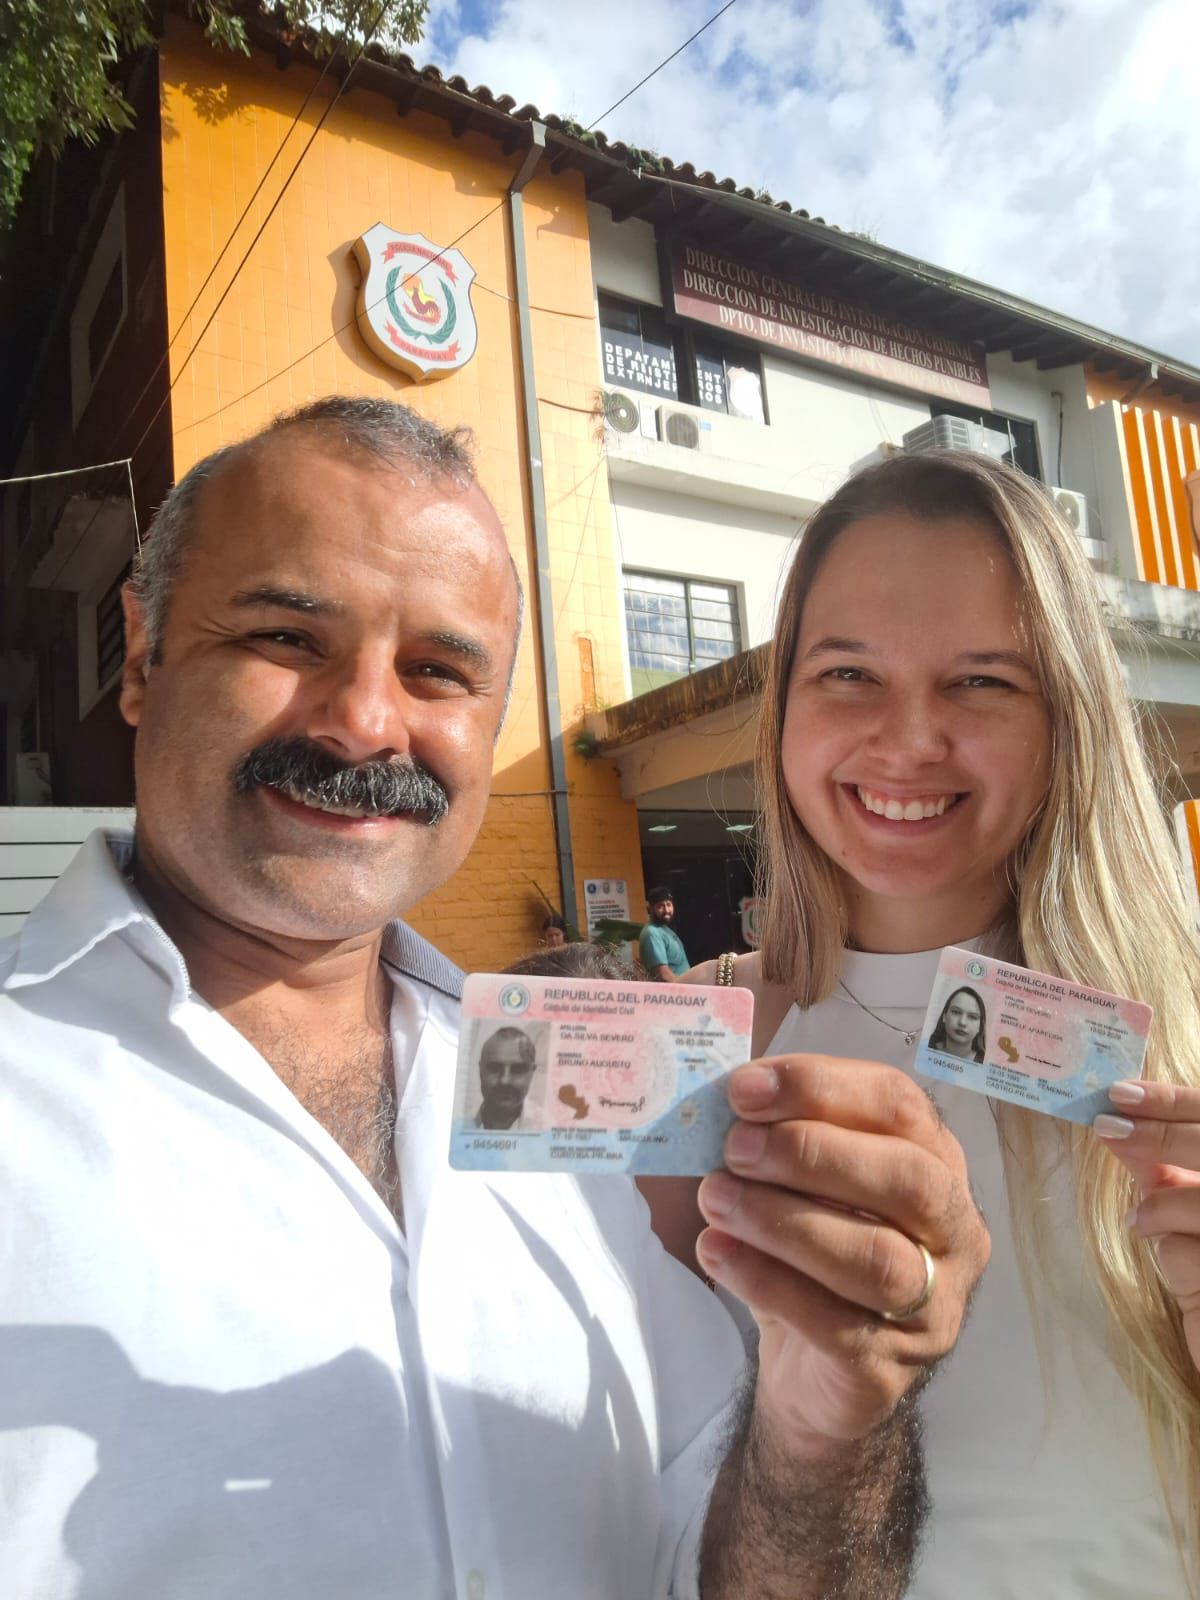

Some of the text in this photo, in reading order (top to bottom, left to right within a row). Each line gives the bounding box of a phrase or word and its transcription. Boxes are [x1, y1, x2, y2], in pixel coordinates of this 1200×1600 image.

[686, 247, 976, 362] DIRECCION GENERAL DE INVESTIGACION CRIMINAL
[683, 269, 981, 384] DIRECCION DE INVESTIGACION DE HECHOS PUNIBLES
[719, 305, 758, 334] DPTO.
[760, 318, 777, 340] DE
[606, 353, 625, 367] DE
[544, 988, 708, 1007] REPUBLICA DEL PARAGUAY
[997, 968, 1117, 1010] REPUBLICA DEL PARAGUAY
[583, 1004, 617, 1014] Identidad
[618, 1006, 635, 1015] Civil
[560, 1032, 635, 1042] DA SILVA SEVERO
[558, 1059, 632, 1069] BRUNO AUGUSTO
